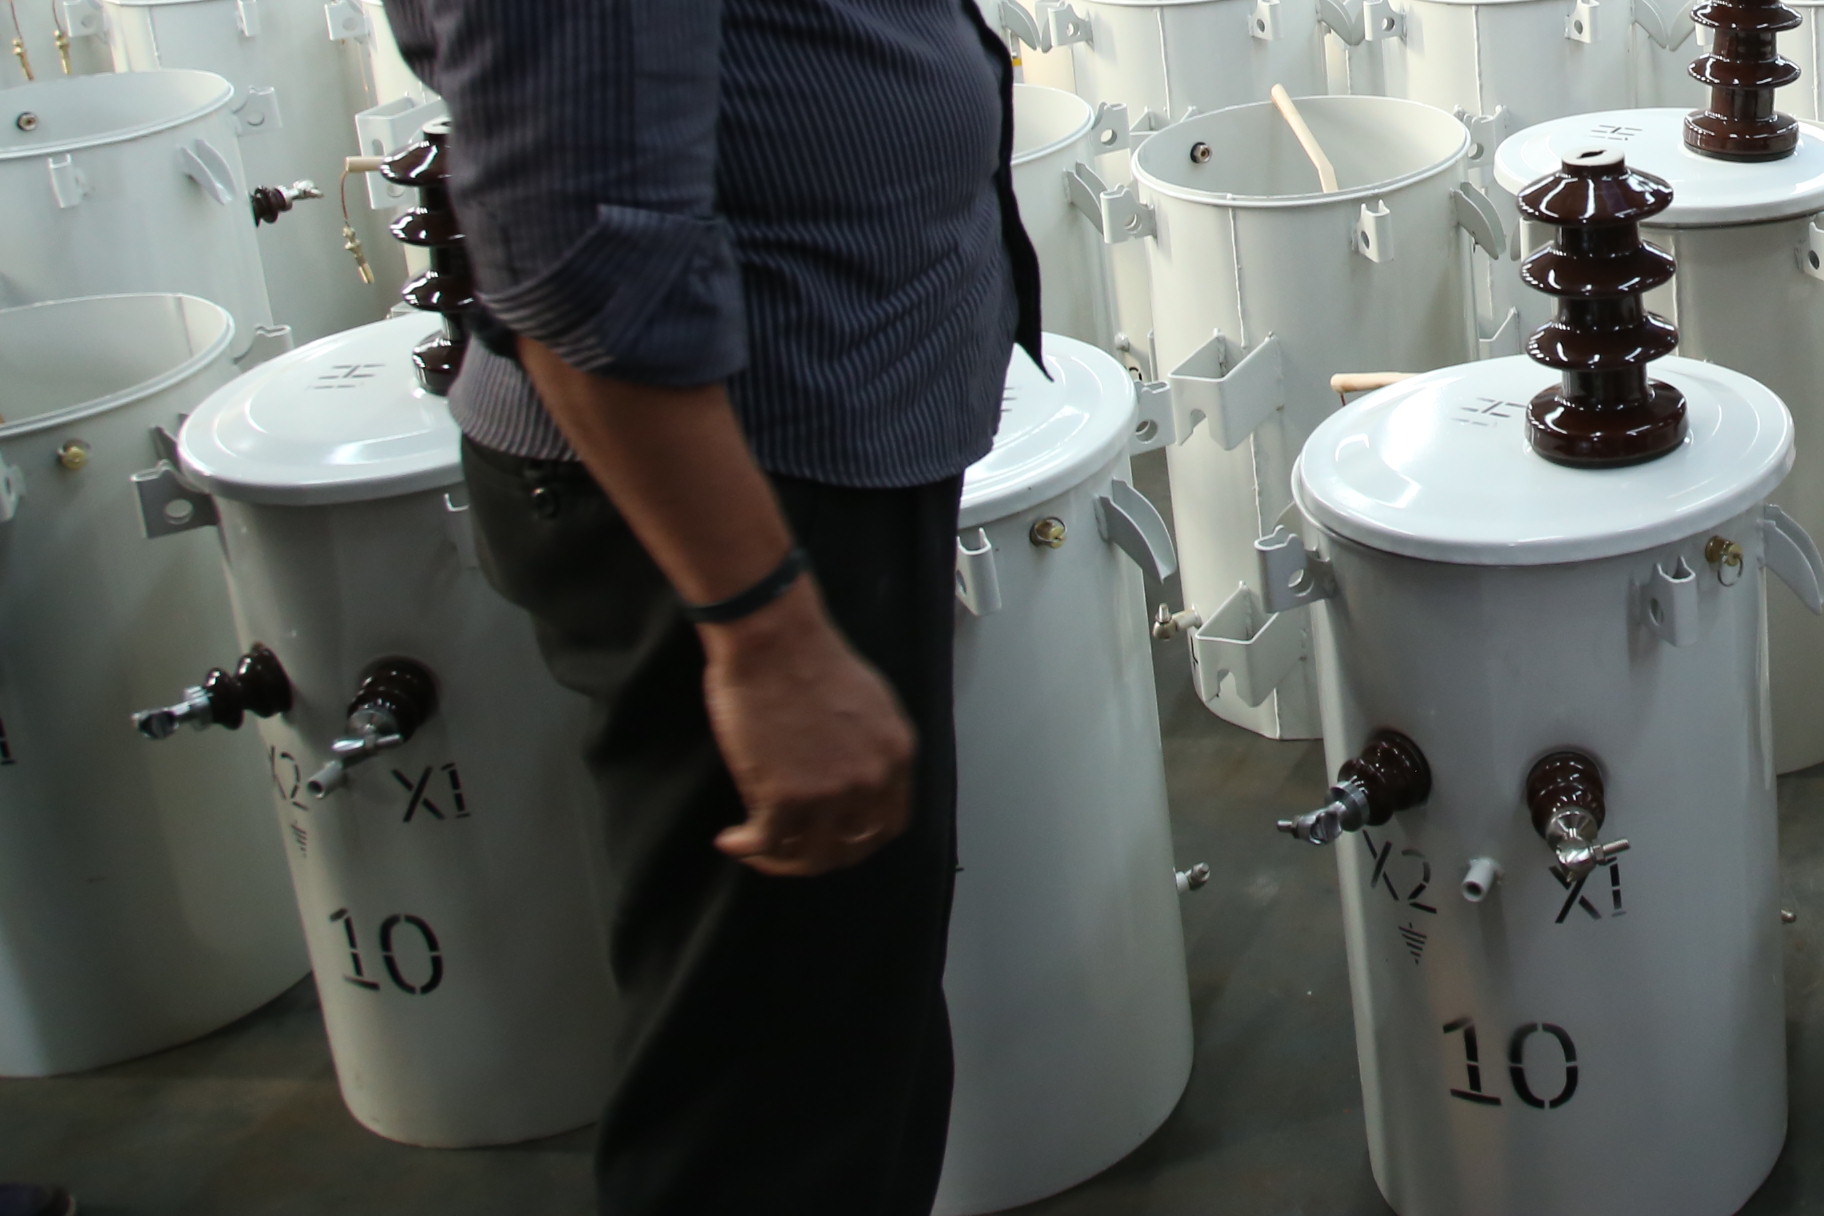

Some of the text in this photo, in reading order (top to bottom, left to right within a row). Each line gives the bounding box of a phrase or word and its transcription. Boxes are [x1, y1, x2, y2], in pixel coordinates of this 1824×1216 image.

[391, 762, 471, 823] X1
[1362, 829, 1627, 924] X2 X1
[329, 907, 444, 996] 10
[1442, 1016, 1579, 1109] 10
